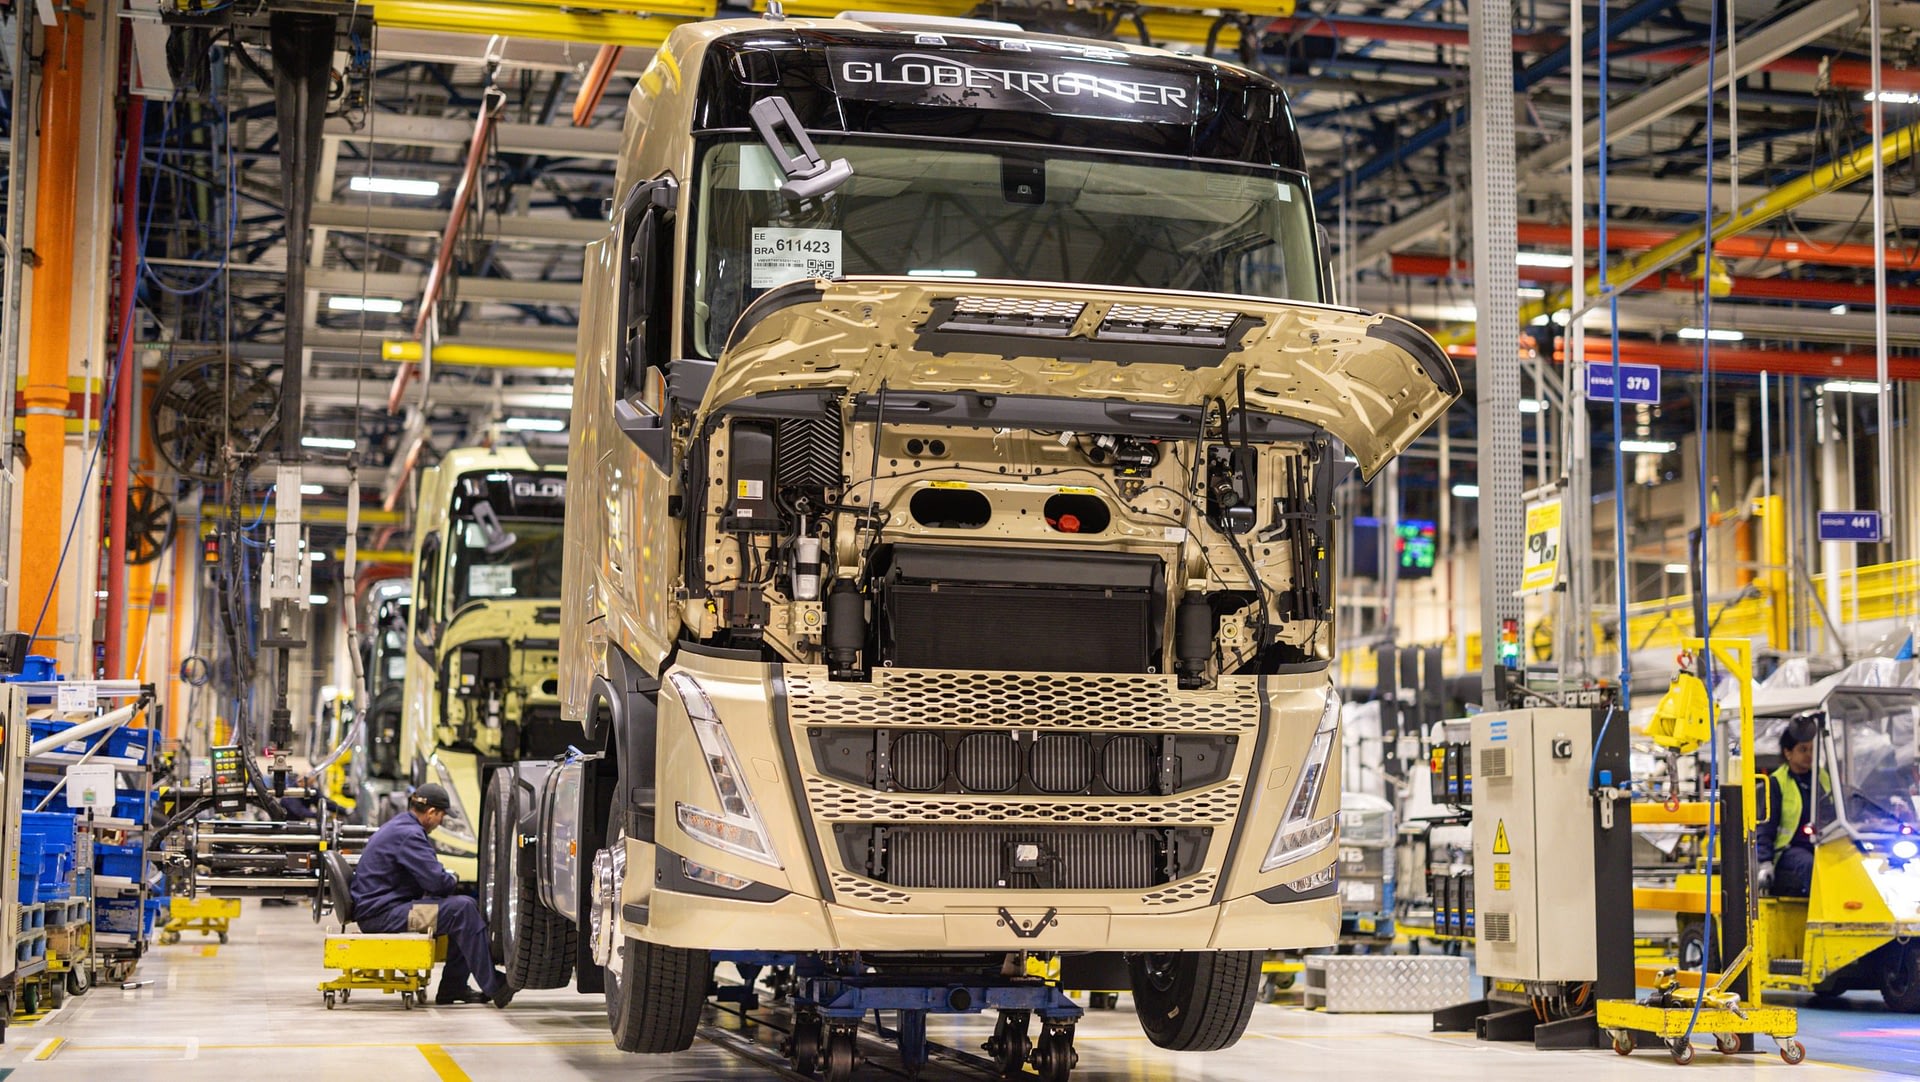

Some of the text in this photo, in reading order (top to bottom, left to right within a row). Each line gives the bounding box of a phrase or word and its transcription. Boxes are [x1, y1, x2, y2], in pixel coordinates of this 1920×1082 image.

[842, 61, 1188, 108] GLOBETROTTER
[754, 238, 830, 255] BRA 611423
[1626, 375, 1650, 391] 379
[1851, 517, 1871, 528] 441
